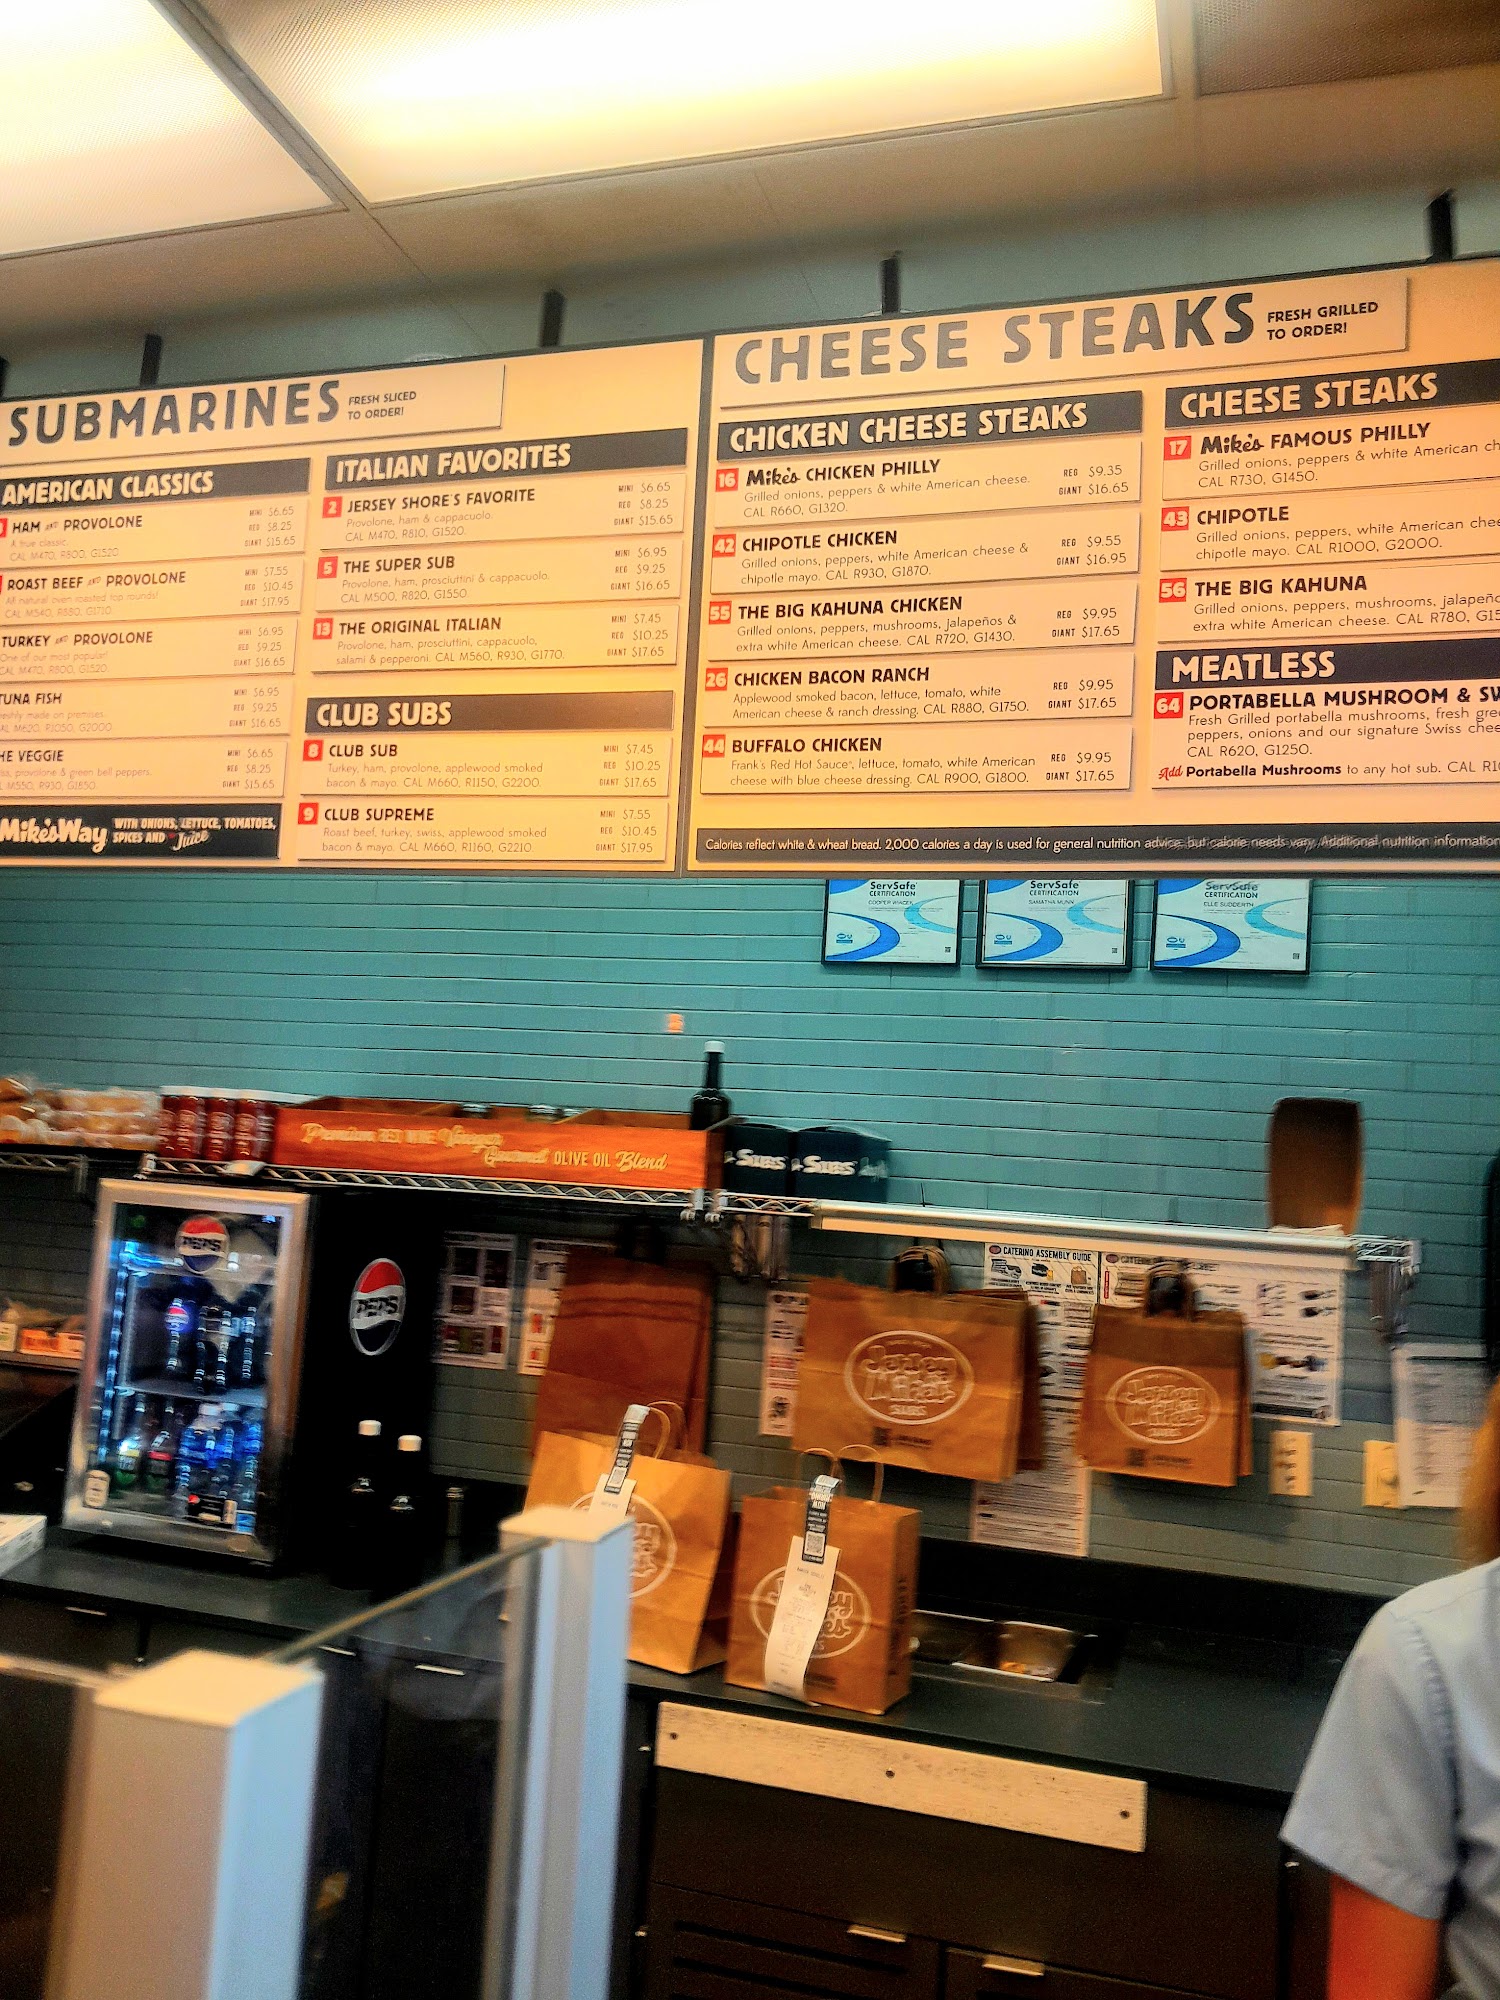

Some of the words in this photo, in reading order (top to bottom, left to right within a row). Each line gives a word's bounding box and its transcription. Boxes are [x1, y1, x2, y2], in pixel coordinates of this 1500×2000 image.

[1268, 308, 1311, 323] FRESH
[1318, 302, 1378, 317] GRILLED
[736, 320, 967, 384] CHEESE
[1004, 292, 1254, 363] STEAKS
[1267, 329, 1285, 340] TO
[1292, 322, 1346, 338] ORDER!
[349, 395, 380, 405] FRESH
[384, 391, 416, 402] SLICED
[1181, 385, 1300, 418] CHEESE
[1315, 372, 1437, 408] STEAKS
[6, 377, 339, 446] SUBMARINES
[348, 411, 361, 420] TO
[365, 407, 404, 418] ORDER!
[731, 421, 848, 452] CHICKEN
[860, 412, 966, 442] CHEESE
[979, 403, 1086, 434] STEAKS
[1168, 441, 1186, 455] 17
[1201, 434, 1264, 454] Mike's
[1272, 429, 1352, 449] FAMOUS
[1361, 422, 1430, 442] PHILLY
[336, 454, 428, 482] ITALIAN
[438, 443, 570, 475] FAVORITES
[1064, 468, 1078, 476] REG
[1089, 465, 1122, 477] $9.35
[718, 473, 736, 487] 16
[746, 467, 800, 486] Mike's
[806, 464, 874, 481] CHICKEN
[882, 459, 940, 476] PHILLY
[2, 478, 113, 505] AMERICAN
[121, 471, 213, 498] CLASSICS
[641, 482, 670, 493] $6.65
[745, 490, 779, 502] Grilled
[784, 490, 823, 500] onions,
[829, 488, 872, 500] peppers
[877, 484, 886, 494] &
[891, 482, 921, 492] white
[926, 480, 980, 490] American
[986, 475, 1030, 486] cheese.
[1059, 486, 1081, 495] GIANT
[1088, 482, 1128, 495] $16.65
[268, 506, 294, 516] $6.65
[328, 502, 337, 515] 2
[348, 498, 396, 512] JERSEY
[402, 494, 460, 509] SHORE'S
[466, 489, 534, 504] FAVORITE
[13, 522, 40, 533] HAM
[64, 516, 142, 531] PROVOLONE
[1163, 511, 1188, 526] 43
[1198, 506, 1288, 524] CHIPOTLE
[714, 539, 735, 553] 42
[743, 535, 820, 551] CHIPOTLE
[828, 530, 896, 547] CHICKEN
[323, 562, 333, 575] 5
[344, 560, 370, 573] THE
[376, 558, 421, 572] SUPER
[427, 556, 454, 569] SUB
[8, 578, 47, 590] ROAST
[53, 577, 83, 589] BEEF
[106, 571, 186, 587] PROVOLONE
[1160, 583, 1185, 598] 56
[1195, 581, 1231, 596] THE
[1240, 579, 1272, 594] BIG
[1282, 576, 1366, 593] KAHUNA
[710, 605, 730, 620] 55
[738, 606, 768, 619] THE
[776, 604, 803, 618] BIG
[812, 600, 883, 616] KAHUNA
[891, 596, 962, 612] CHICKEN
[1057, 610, 1071, 618] REG
[1083, 608, 1116, 620] $9.95
[316, 624, 330, 636] 13
[339, 622, 365, 634] THE
[372, 620, 440, 633] ORIGINAL
[447, 617, 501, 631] ITALIAN
[2, 636, 50, 647] TURKEY
[74, 631, 152, 645] PROVOLONE
[1173, 651, 1334, 682] MEATLESS
[707, 673, 727, 687] 26
[735, 672, 801, 686] CHICKEN
[809, 670, 864, 684] BACON
[872, 667, 929, 682] RANCH
[1079, 679, 1113, 691] $9.95
[36, 693, 62, 704] FISH
[1156, 698, 1181, 713] 64
[1190, 692, 1315, 710] PORTABELLA
[1324, 688, 1447, 706] MUSHROOM
[1456, 689, 1471, 702] &
[318, 703, 378, 726] CLUB
[388, 702, 451, 725] SUBS
[308, 745, 318, 758] 8
[330, 745, 363, 757] CLUB
[371, 744, 397, 756] SUB
[703, 739, 724, 754] 44
[733, 739, 805, 753] BUFFALO
[813, 738, 881, 752] CHICKEN
[19, 750, 63, 762] VEGGIE
[1051, 754, 1065, 762] REG
[1077, 752, 1111, 764] $9.95
[1158, 766, 1183, 781] Add
[1187, 765, 1256, 777] Portabella
[1263, 764, 1341, 775] Mushrooms
[1348, 765, 1358, 774] to
[1364, 767, 1386, 777] any
[1392, 763, 1410, 773] hot
[1416, 762, 1440, 773] sub.
[114, 818, 138, 829] WITH
[224, 817, 276, 830] TOMATOES,
[304, 808, 313, 821] 9
[325, 809, 359, 820] CLUB
[366, 808, 434, 820] SUPREME
[113, 832, 143, 843] SPICES
[145, 832, 166, 843] AND
[706, 838, 742, 849] Calories
[746, 838, 775, 850] reflect
[778, 838, 804, 849] white
[807, 838, 815, 849] &
[818, 838, 848, 849] wheat
[852, 838, 881, 849] bread.
[886, 838, 919, 850] 2,000
[922, 838, 960, 849] calories
[964, 841, 971, 849] a
[974, 838, 993, 852] day
[996, 840, 1003, 849] is
[1008, 837, 1032, 849] used
[1036, 837, 1050, 849] for
[1053, 837, 1093, 853] general
[1097, 838, 1140, 848] nutrition
[871, 882, 915, 890] ServSafe
[1031, 880, 1078, 888] ServSafe
[554, 1150, 589, 1166] OLIVE
[593, 1152, 611, 1167] OIL
[615, 1152, 667, 1172] Blend
[1036, 1250, 1070, 1260] ASSEMBLY
[1073, 1252, 1091, 1261] GUIDE
